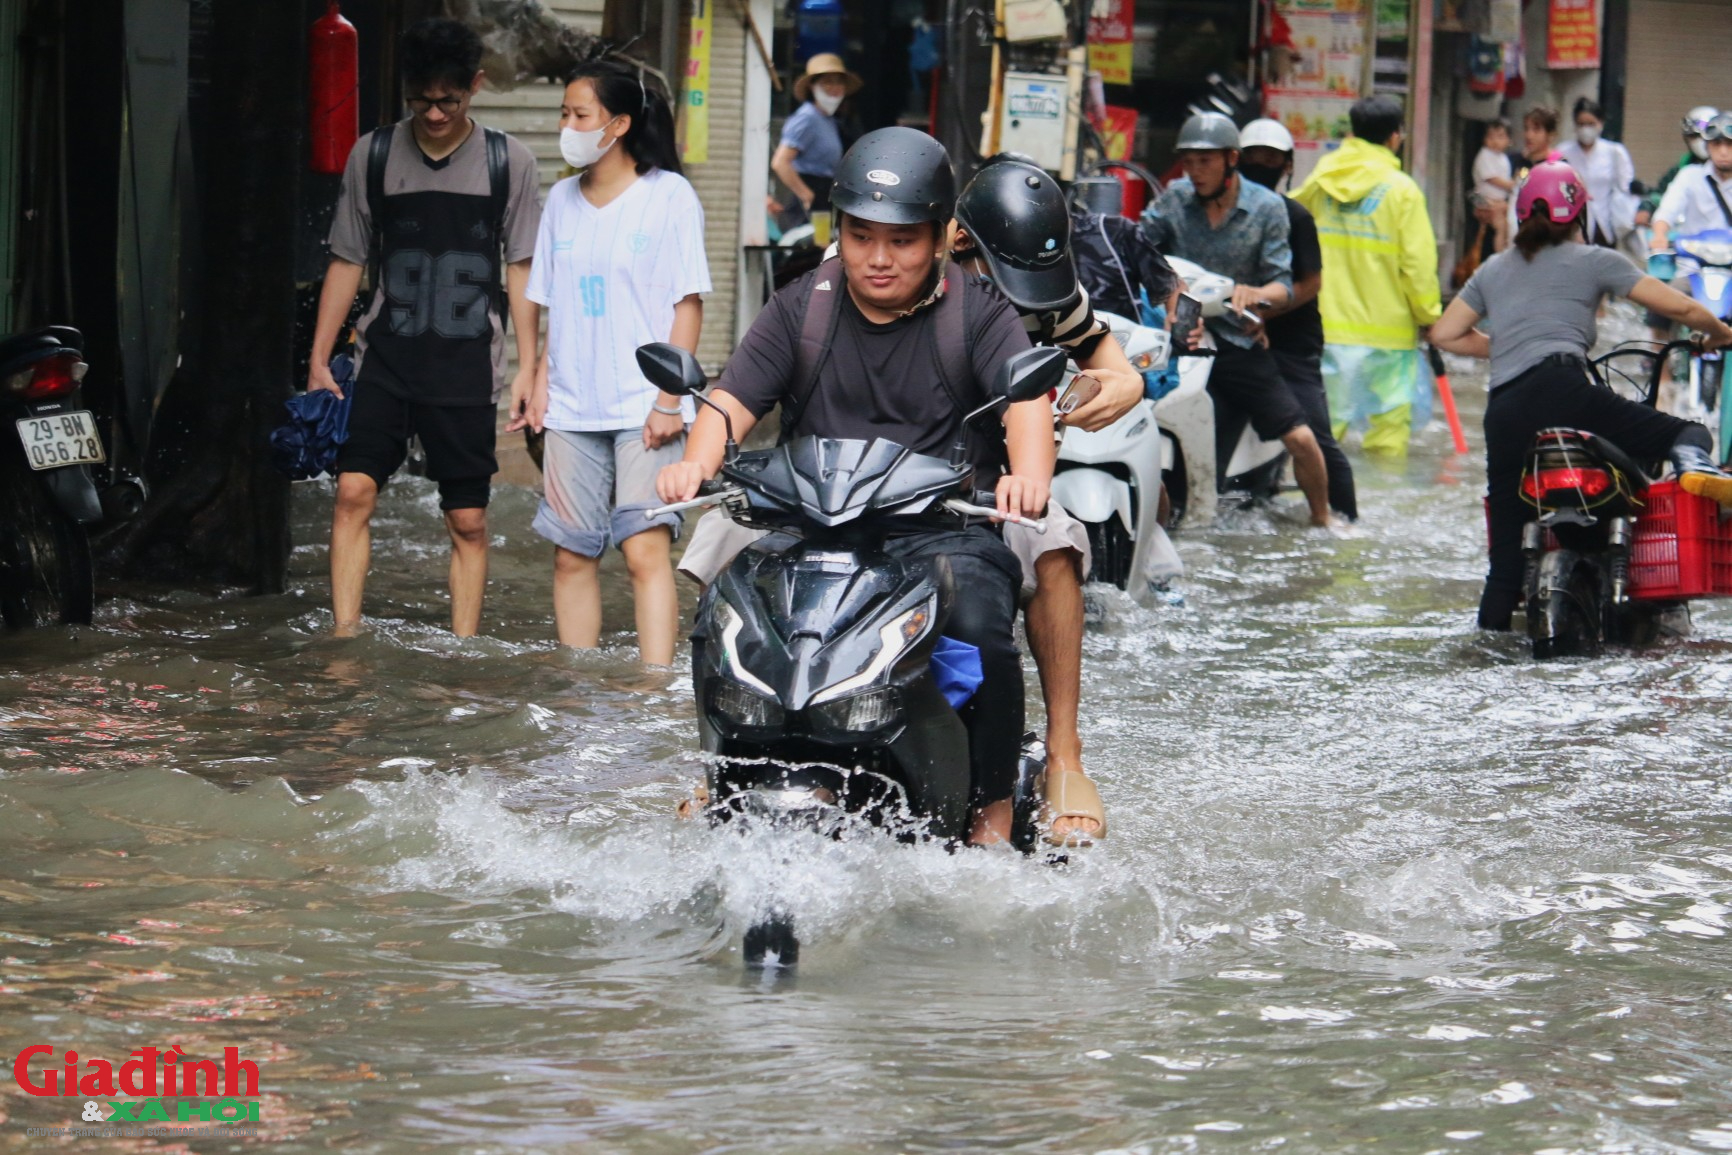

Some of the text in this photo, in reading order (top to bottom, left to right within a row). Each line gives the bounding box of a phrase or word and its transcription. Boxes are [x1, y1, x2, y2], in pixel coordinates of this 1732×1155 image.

[386, 248, 492, 339] 96
[579, 275, 605, 317] 10
[29, 415, 86, 442] 29-BN
[31, 438, 99, 465] 056.28
